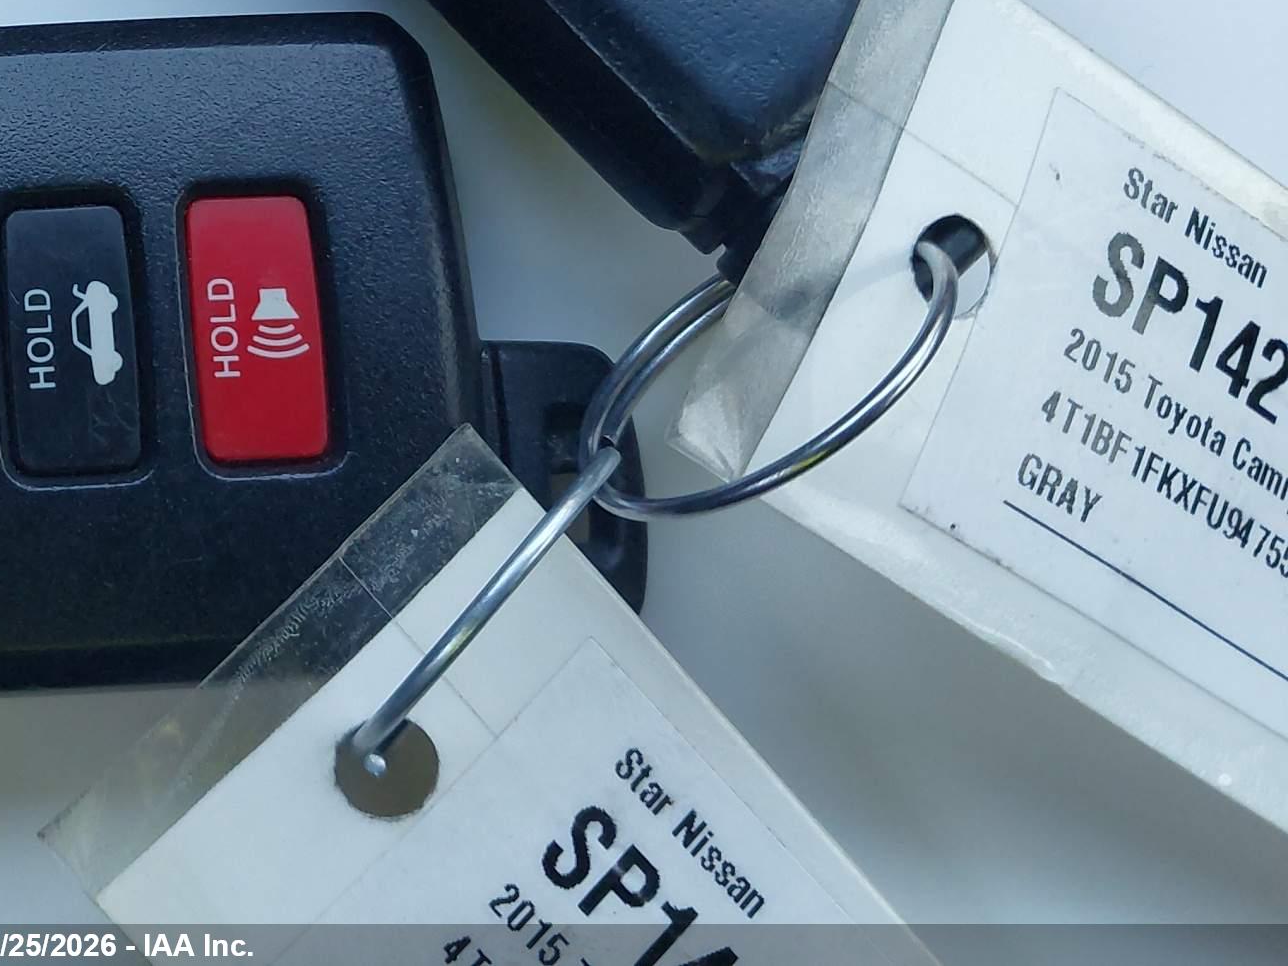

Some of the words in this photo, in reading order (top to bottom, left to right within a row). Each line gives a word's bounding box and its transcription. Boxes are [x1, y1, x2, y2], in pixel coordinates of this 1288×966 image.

[1123, 167, 1178, 224] Star
[1184, 206, 1268, 288] Nissan
[23, 288, 57, 390] HOLD
[206, 278, 241, 378] HOLD
[1093, 232, 1288, 425] SP142
[1064, 328, 1136, 394] 2015
[1144, 374, 1227, 457] Toyota
[1232, 437, 1288, 514] Camr
[1018, 453, 1103, 523] GRAY
[615, 747, 675, 816] Star
[672, 809, 766, 919] Nissan
[489, 883, 570, 966] 2015
